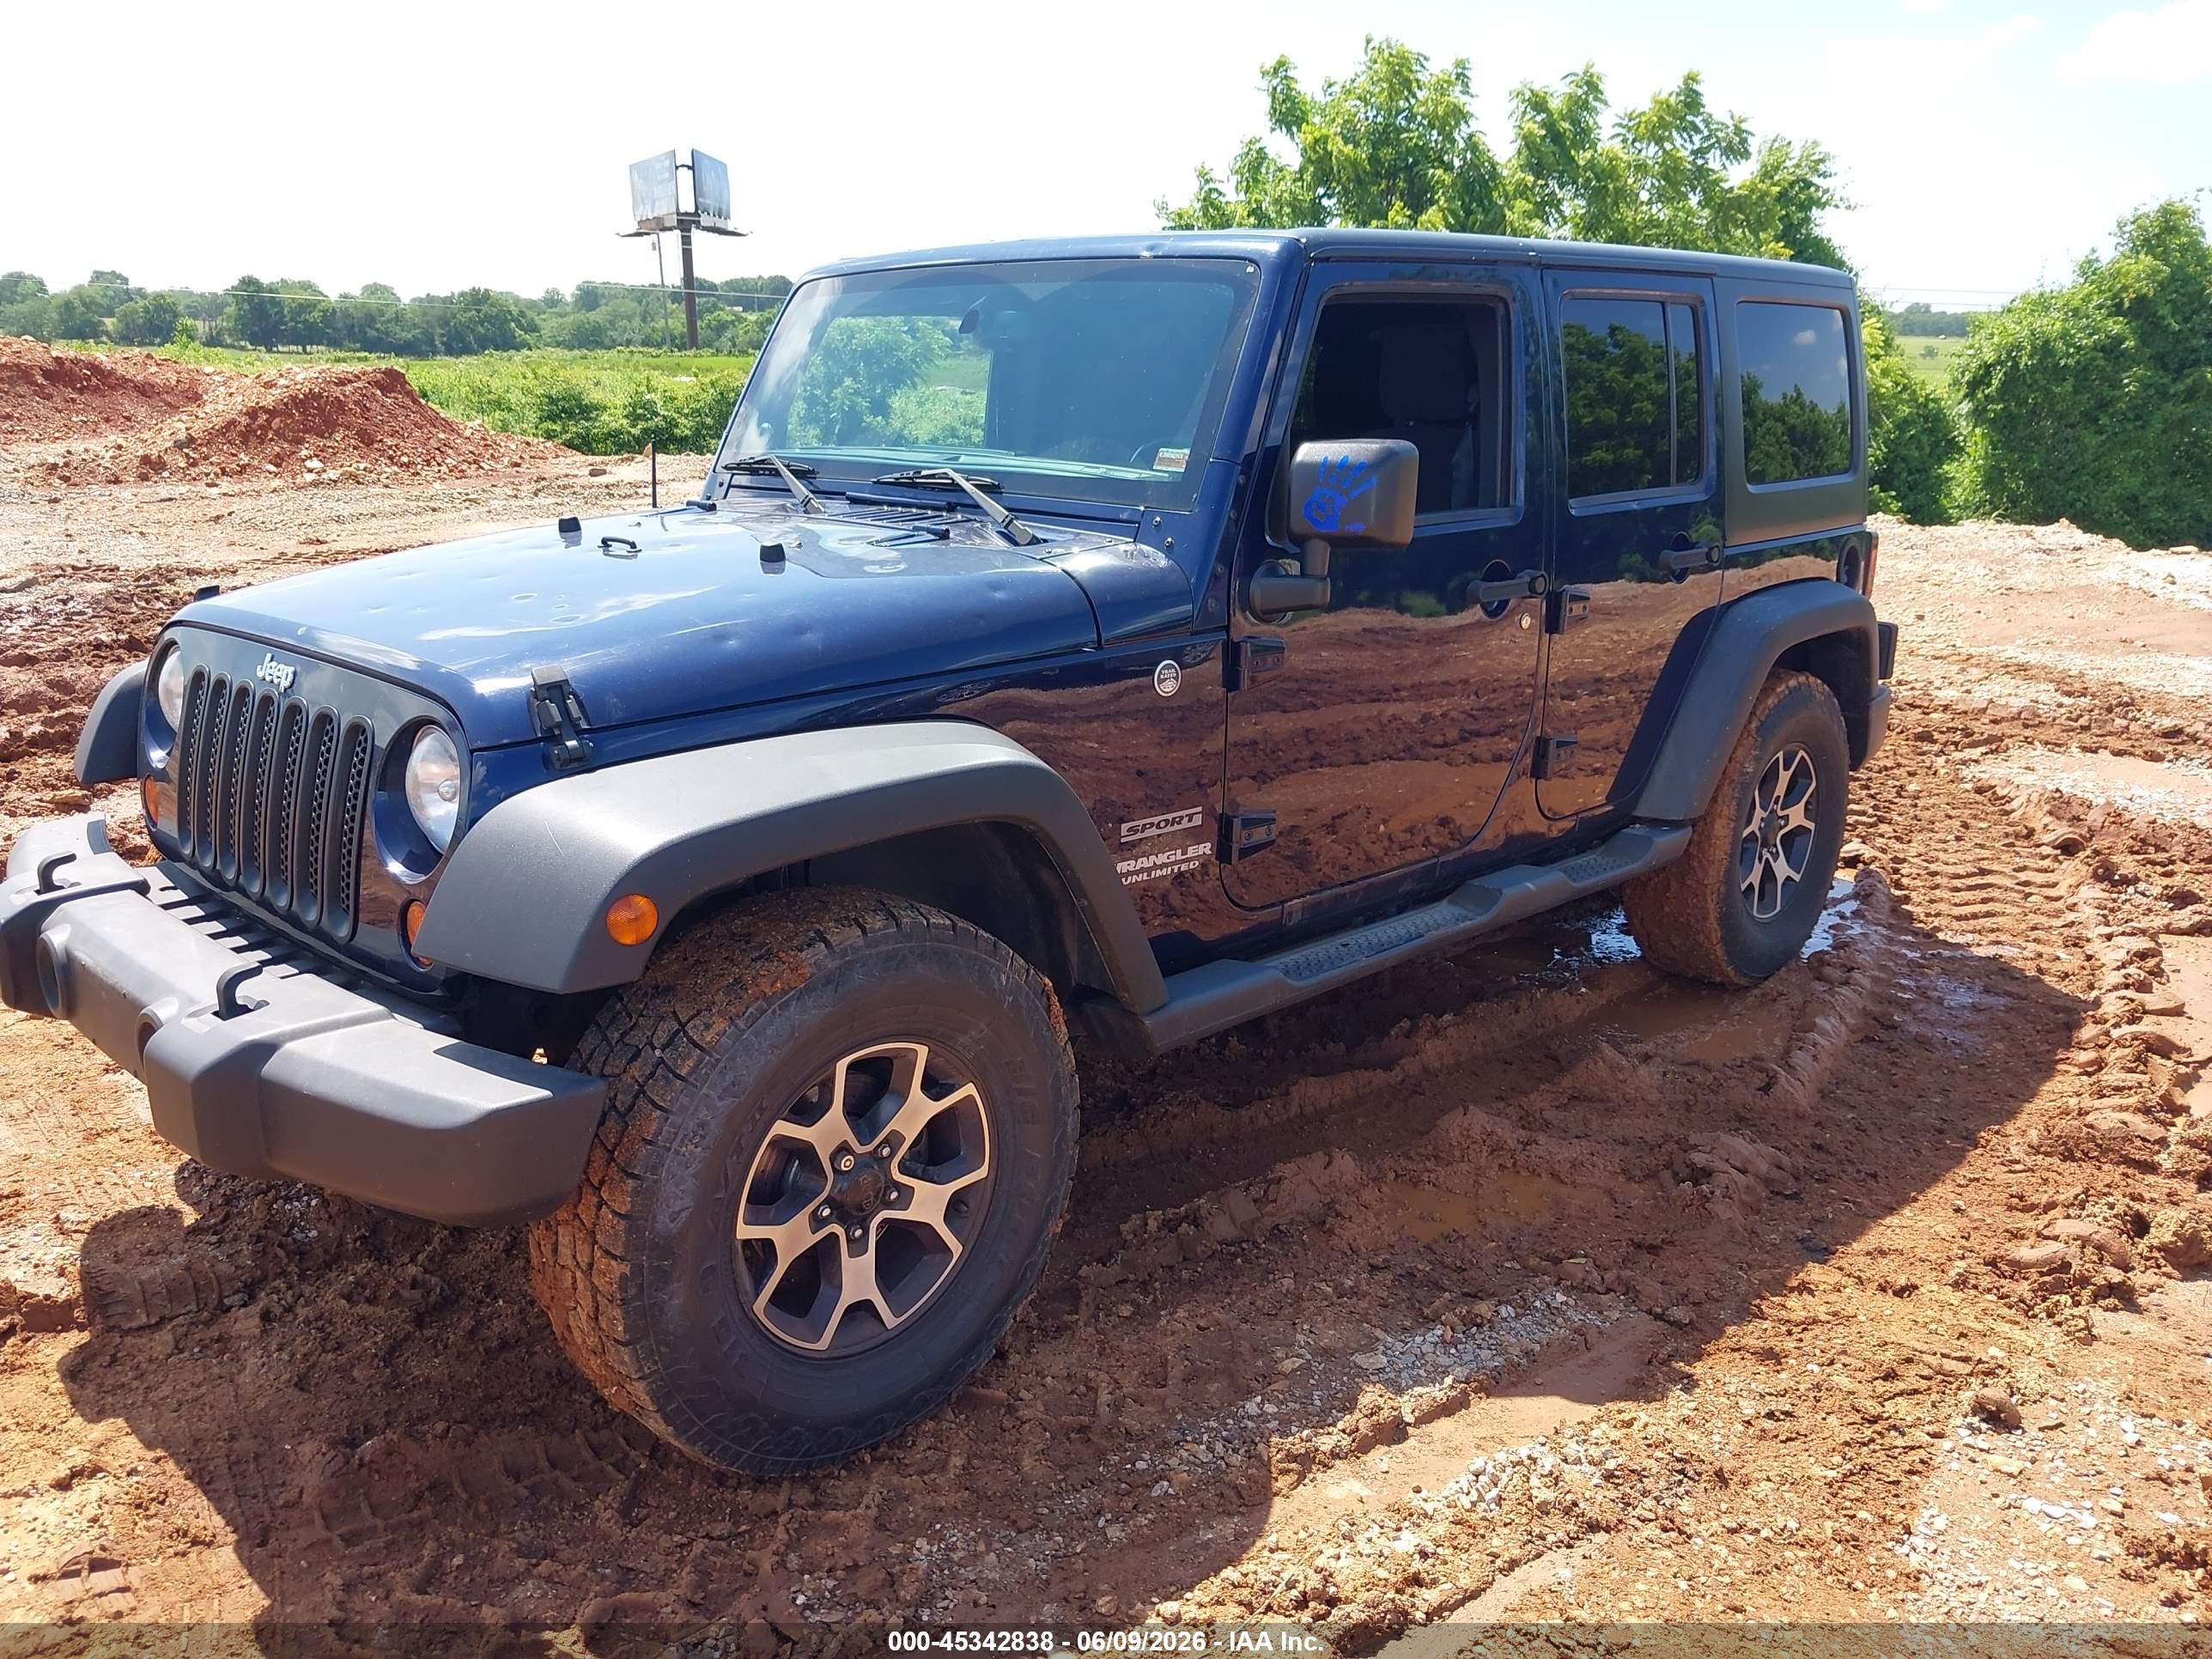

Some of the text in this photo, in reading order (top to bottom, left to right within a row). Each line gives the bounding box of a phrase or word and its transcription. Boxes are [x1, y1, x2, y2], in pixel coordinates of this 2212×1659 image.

[257, 653, 295, 693] Jeep
[1121, 811, 1202, 838] SPORT
[1121, 860, 1200, 885] UNLIMITED
